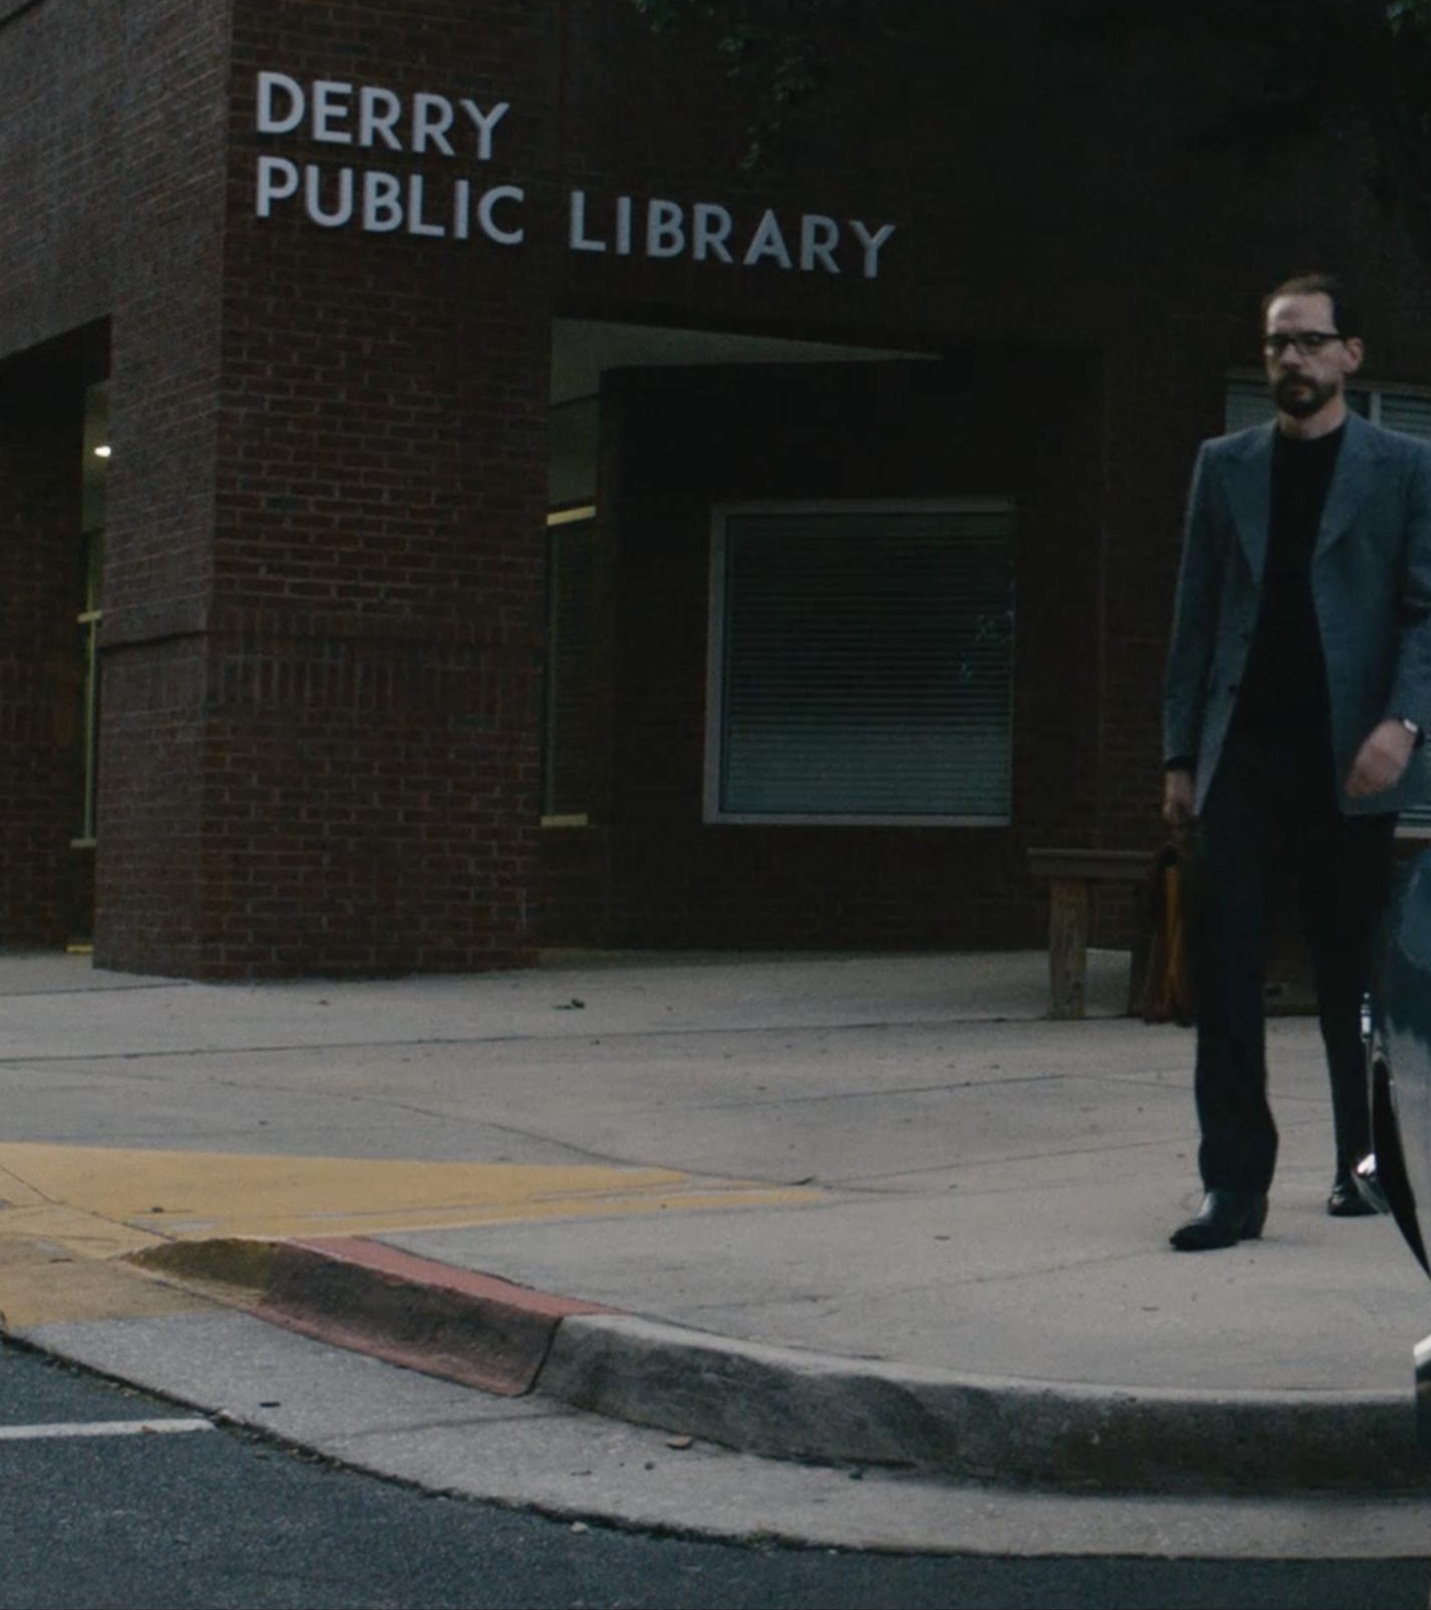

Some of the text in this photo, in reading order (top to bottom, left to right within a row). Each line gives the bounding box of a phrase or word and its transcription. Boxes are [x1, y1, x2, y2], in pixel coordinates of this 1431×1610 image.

[254, 71, 510, 160] DERRY
[254, 155, 896, 279] PUBLIC LIBRARY
